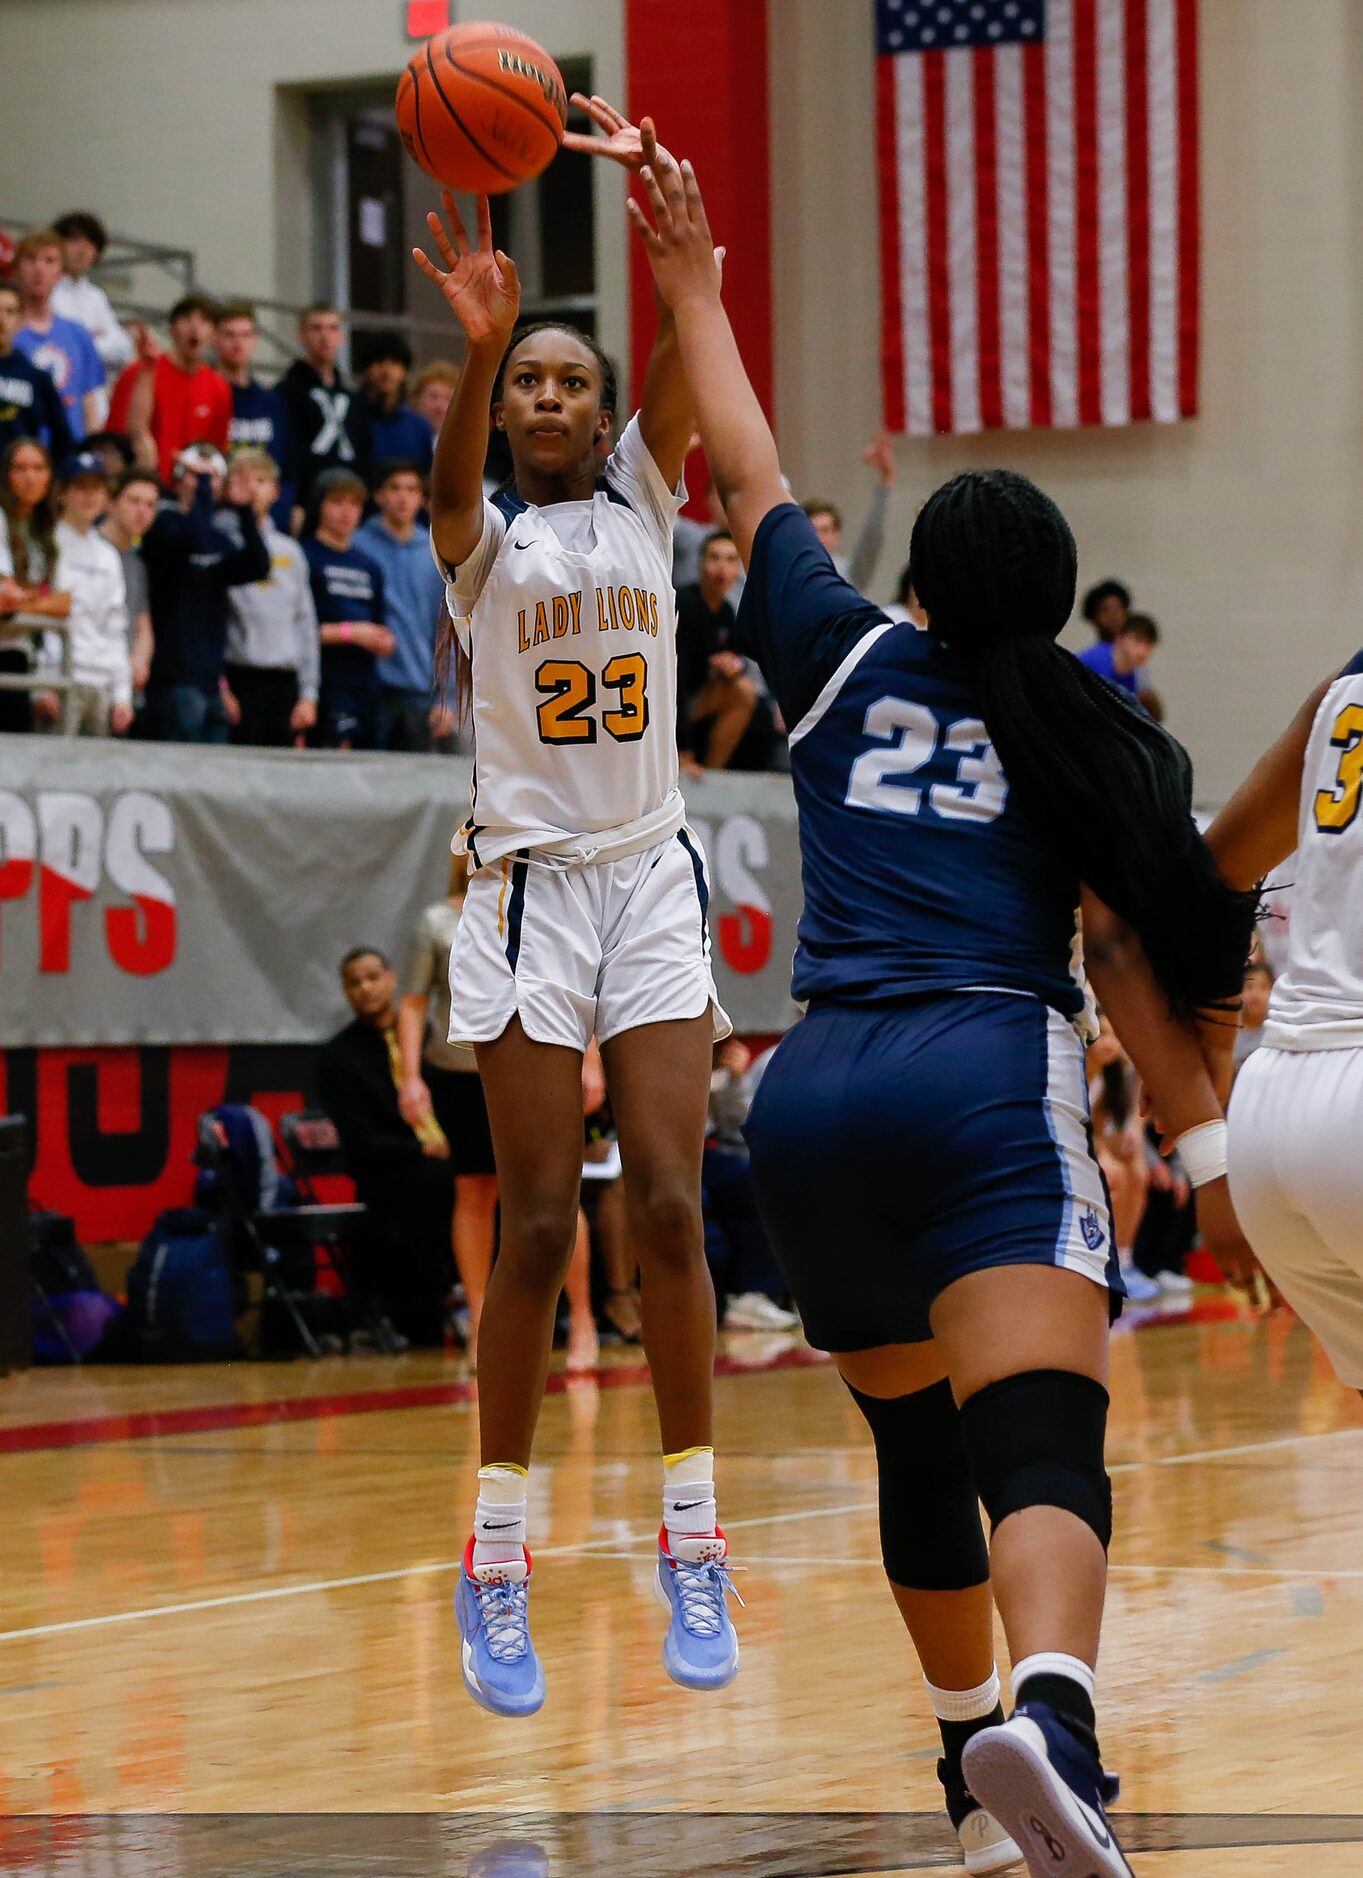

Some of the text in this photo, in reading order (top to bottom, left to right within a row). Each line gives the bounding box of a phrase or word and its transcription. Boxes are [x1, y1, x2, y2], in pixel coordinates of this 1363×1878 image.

[516, 585, 659, 653] LADY LIONS
[535, 652, 648, 745] 23
[844, 695, 1010, 823] 23
